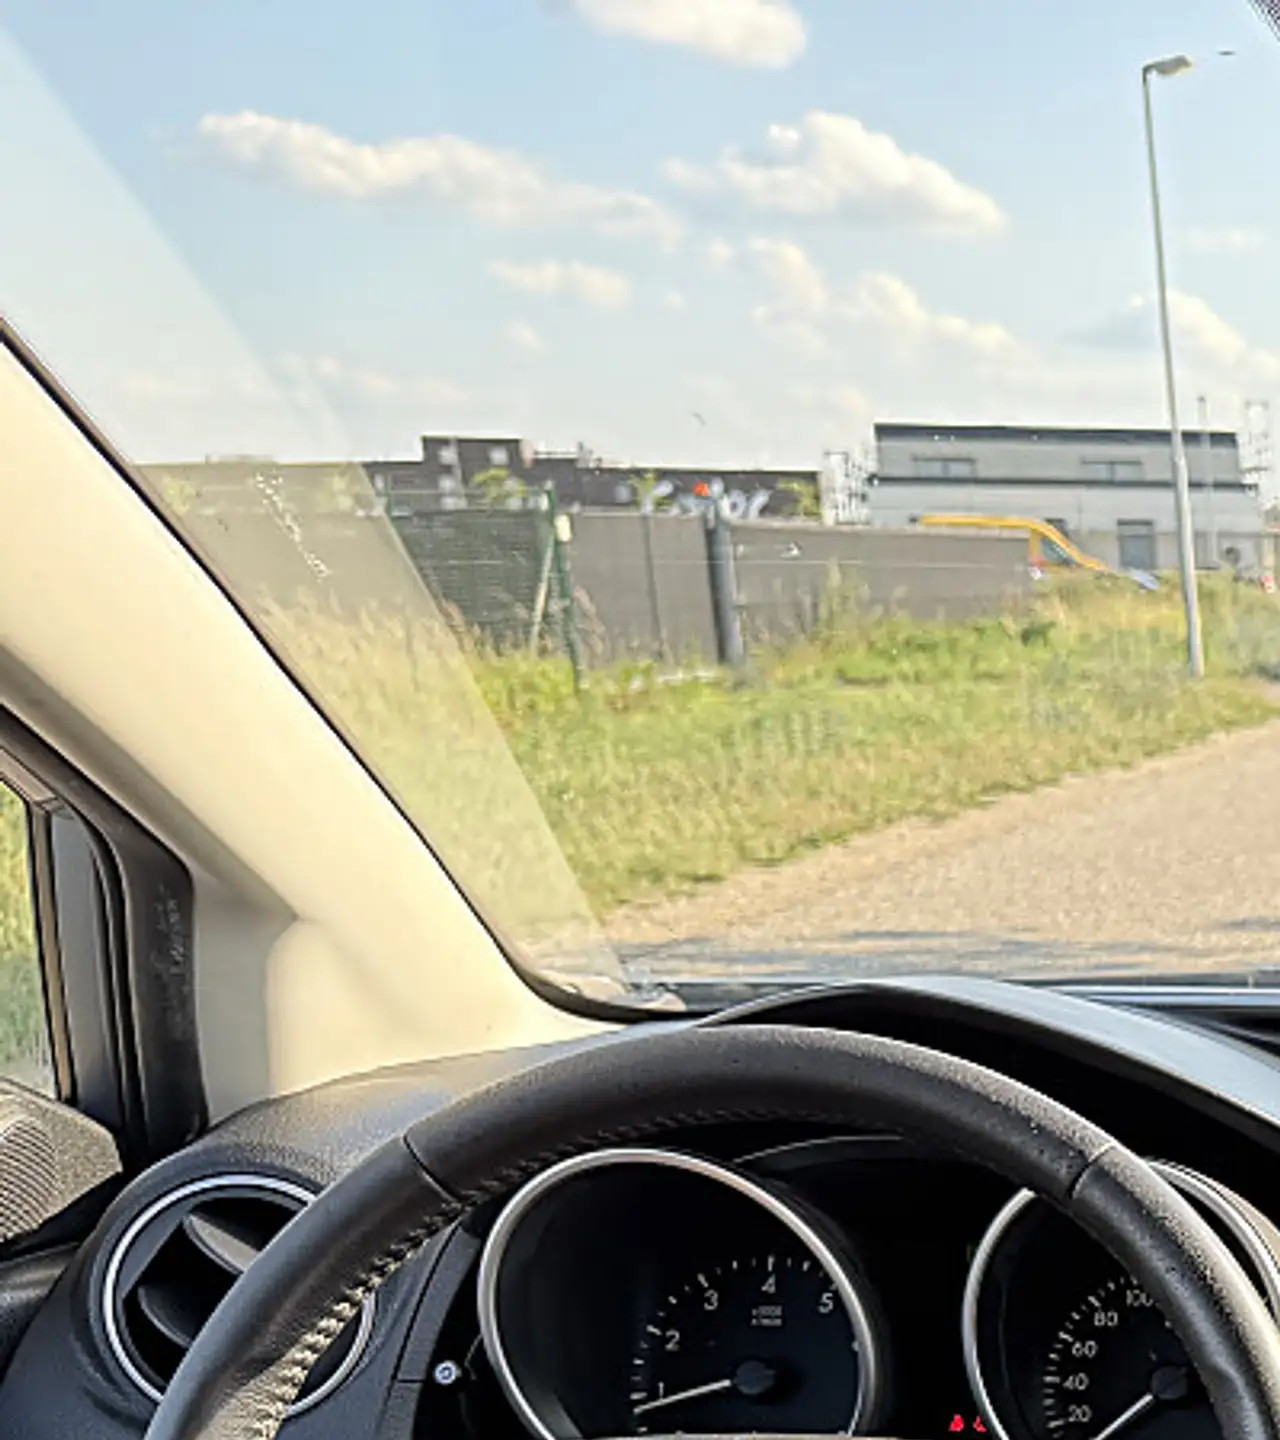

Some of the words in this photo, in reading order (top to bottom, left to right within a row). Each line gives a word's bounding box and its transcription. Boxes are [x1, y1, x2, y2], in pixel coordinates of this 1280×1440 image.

[761, 1275, 776, 1294] 4
[703, 1289, 719, 1311] 3
[818, 1292, 834, 1314] 5
[1126, 1289, 1154, 1308] 100
[1093, 1311, 1119, 1328] 80
[665, 1330, 680, 1351] 2
[1071, 1340, 1098, 1357] 60
[657, 1381, 665, 1401] 1
[1063, 1373, 1089, 1391] 40
[1067, 1406, 1092, 1423] 20
